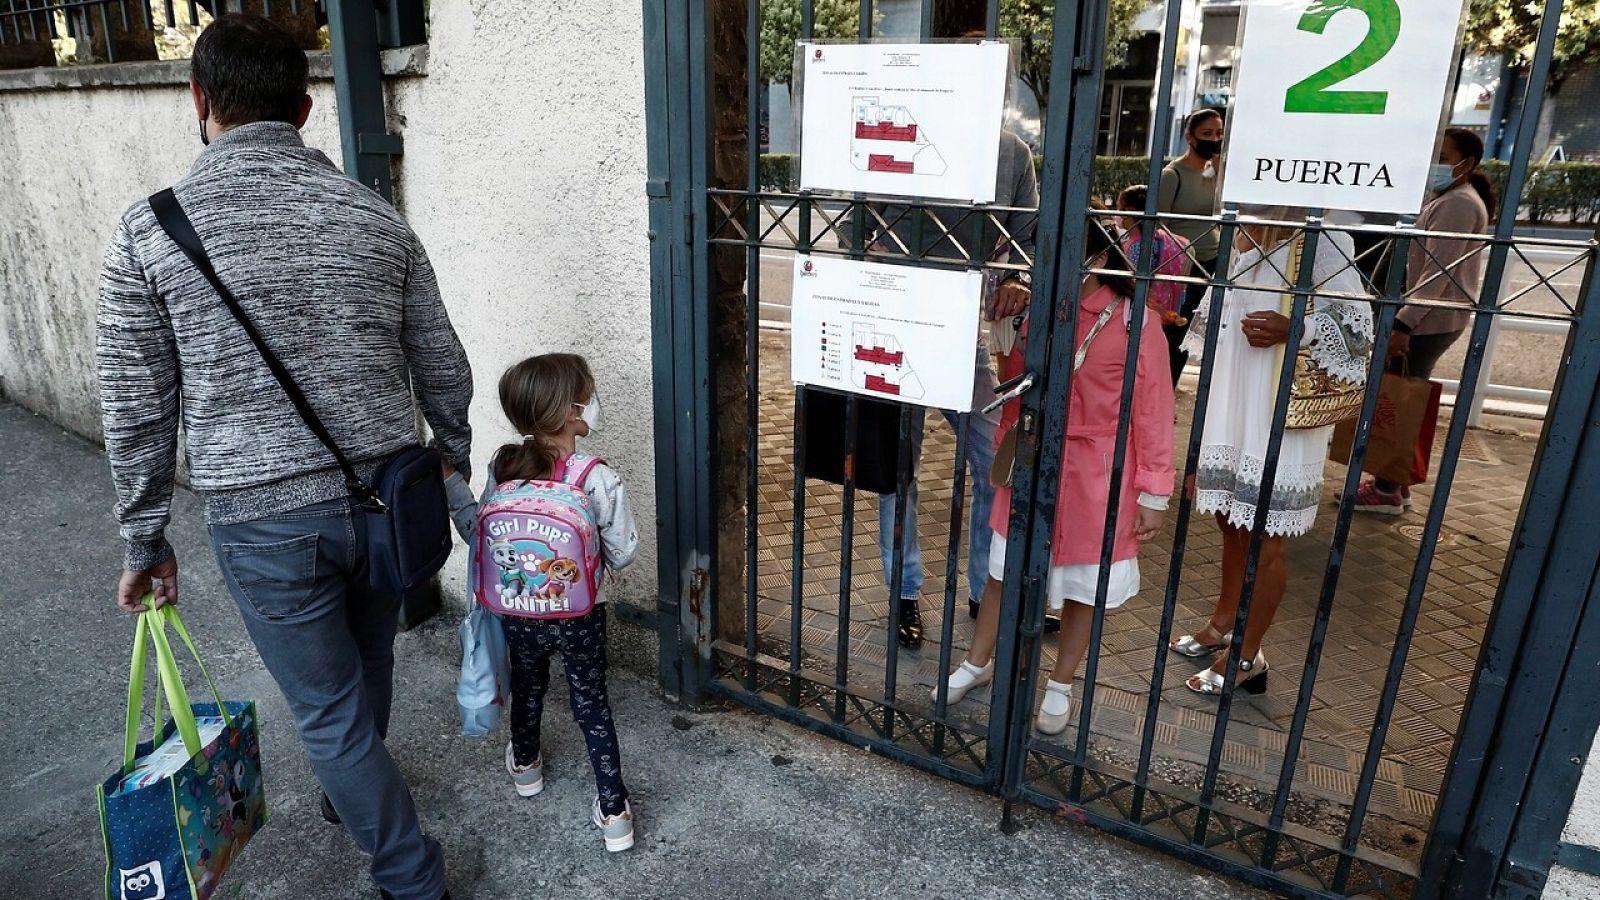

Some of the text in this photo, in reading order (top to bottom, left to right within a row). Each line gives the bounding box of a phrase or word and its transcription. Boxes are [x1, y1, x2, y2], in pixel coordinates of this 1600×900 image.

[1284, 0, 1401, 114] 2
[1252, 158, 1394, 188] PUERTA
[490, 519, 572, 544] Girl Pups
[501, 596, 570, 612] UNITE!
